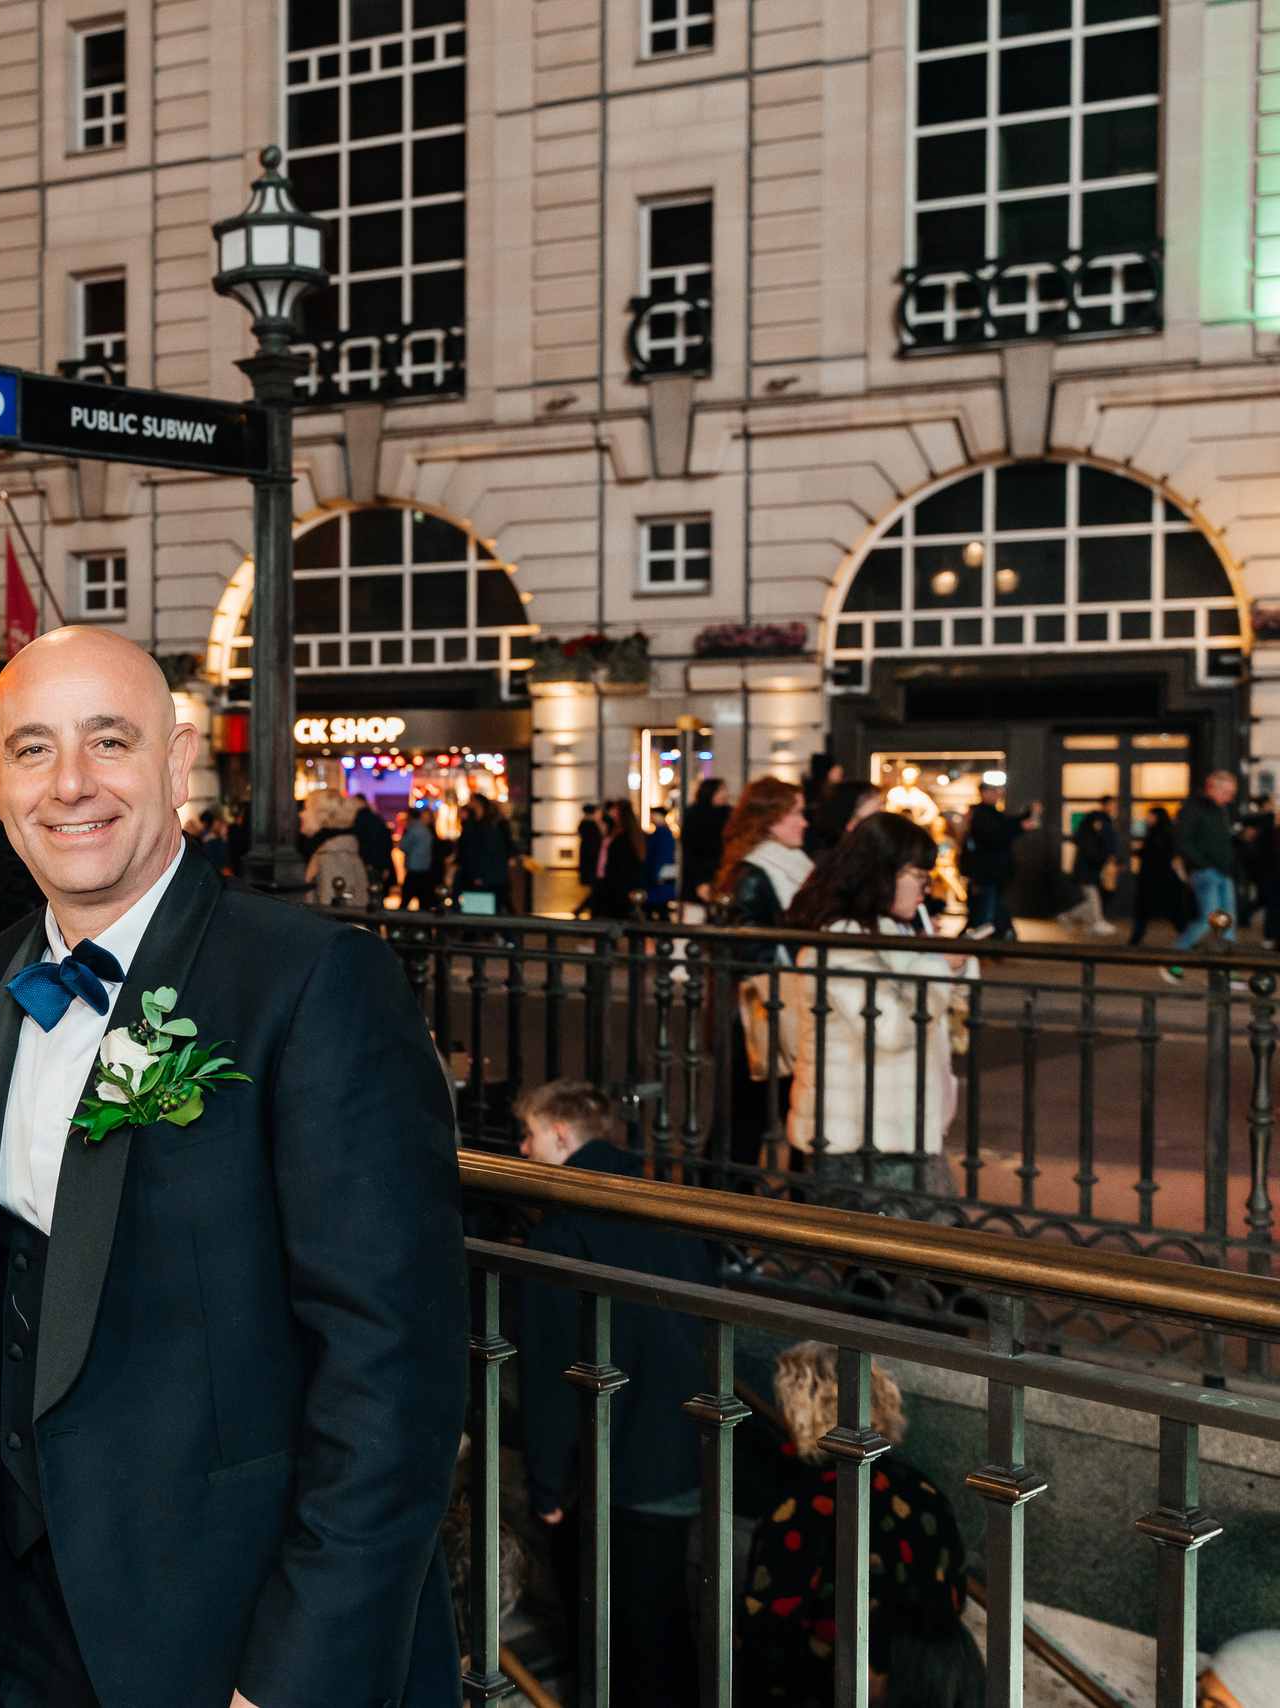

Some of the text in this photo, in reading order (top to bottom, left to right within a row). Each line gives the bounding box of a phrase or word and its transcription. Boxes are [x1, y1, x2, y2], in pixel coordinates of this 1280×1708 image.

[70, 406, 217, 443] PUBLIC SUBWAY
[293, 717, 405, 744] CK SHOP
